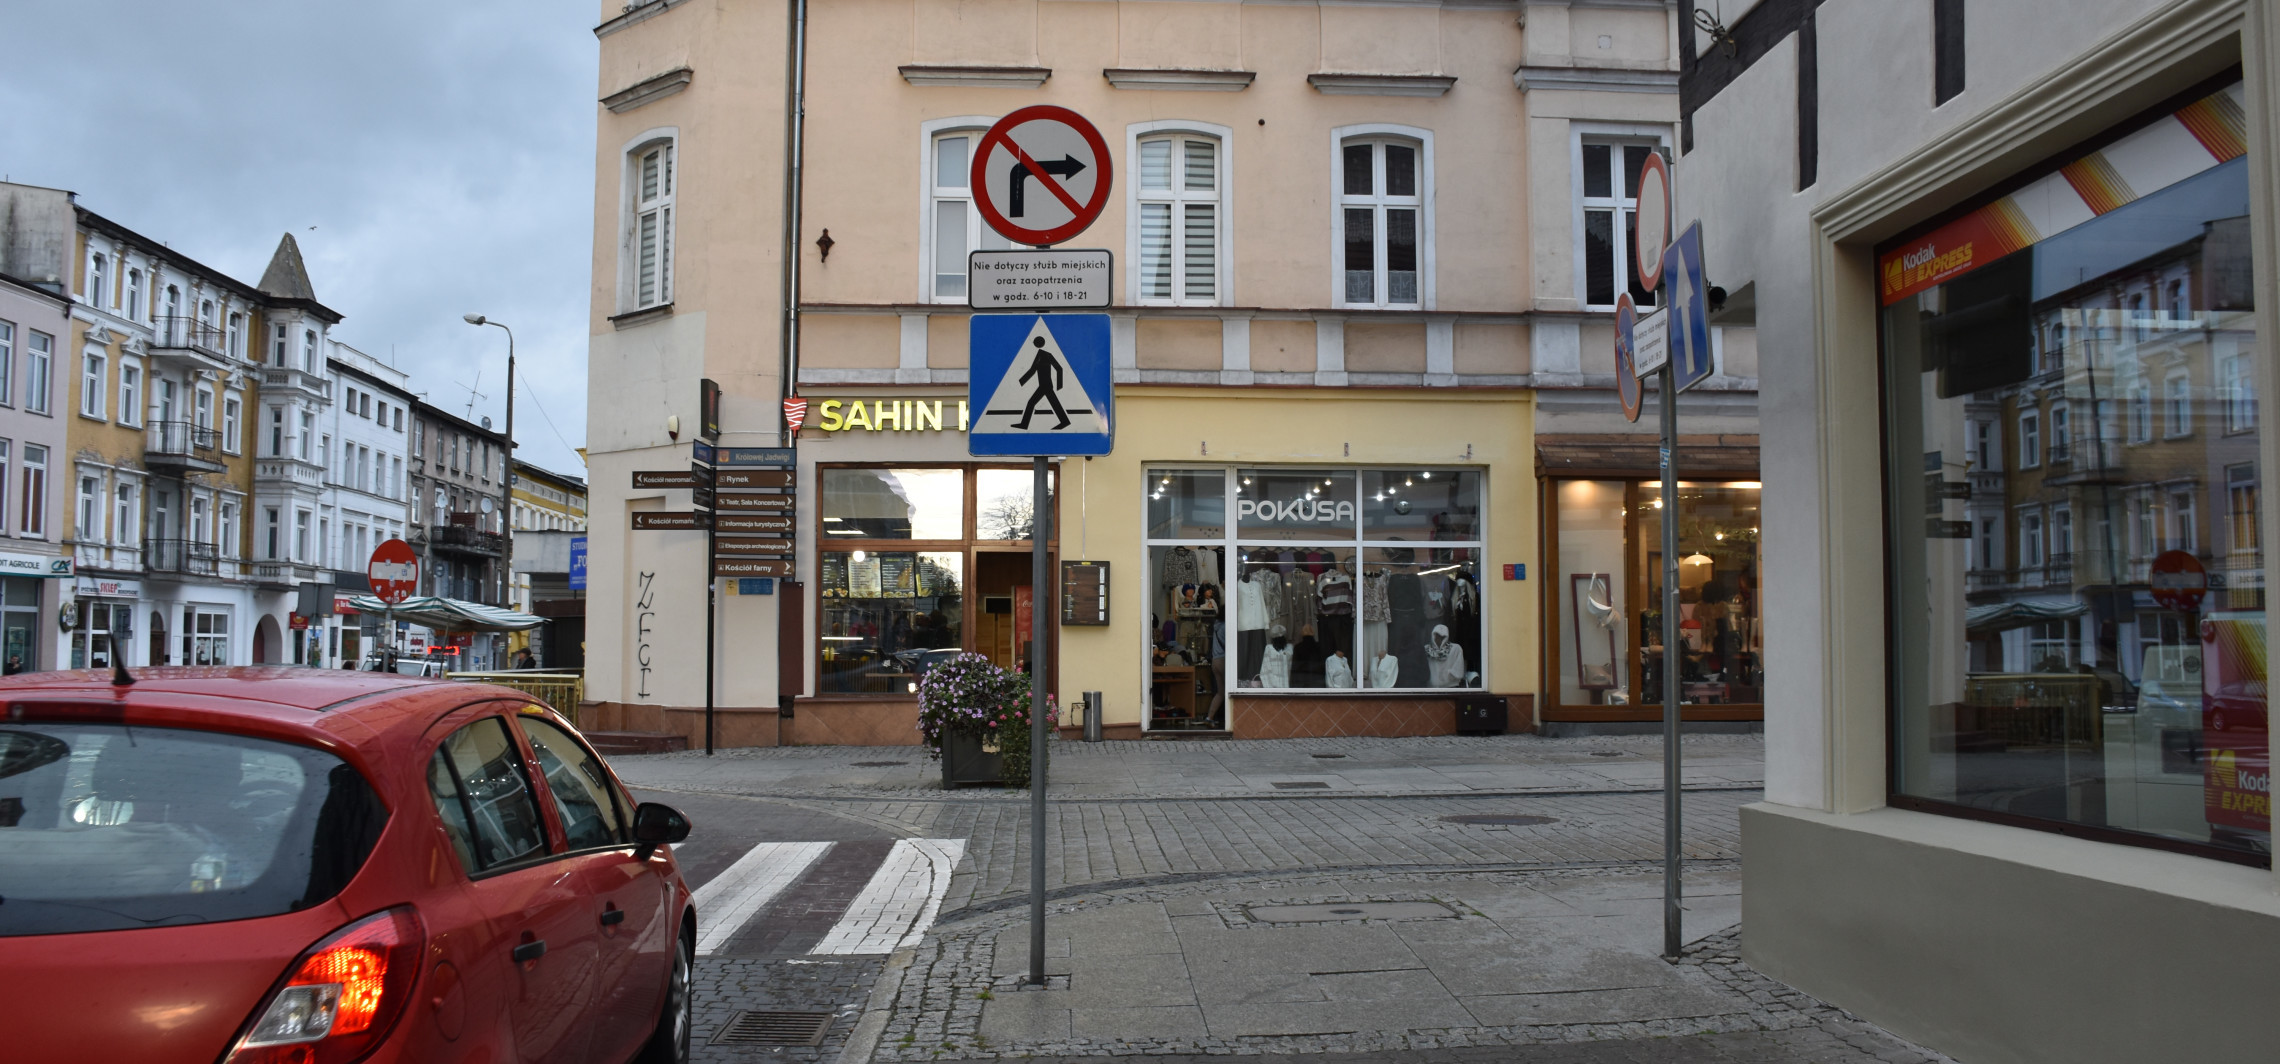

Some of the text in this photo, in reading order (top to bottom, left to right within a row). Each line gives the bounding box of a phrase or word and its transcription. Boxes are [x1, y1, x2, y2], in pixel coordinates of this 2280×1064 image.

[1903, 242, 1936, 271] Kodak
[1917, 241, 1973, 282] EXPRESS
[974, 260, 1106, 271] Nie dotyczy służb miejskich
[1020, 275, 1083, 286] zaopatrzenia
[1004, 292, 1029, 303] godz.
[1033, 292, 1053, 300] 6-10
[1057, 291, 1060, 300] i
[1063, 291, 1088, 300] 18-21
[820, 400, 943, 432] SAHIN
[735, 452, 790, 462] Królowej Jadwigi
[726, 475, 749, 484] Rynek
[1237, 500, 1355, 521] POKUSA
[9, 560, 40, 570] AGRICOLE
[753, 564, 772, 573] farny
[100, 582, 118, 594] SKLEP
